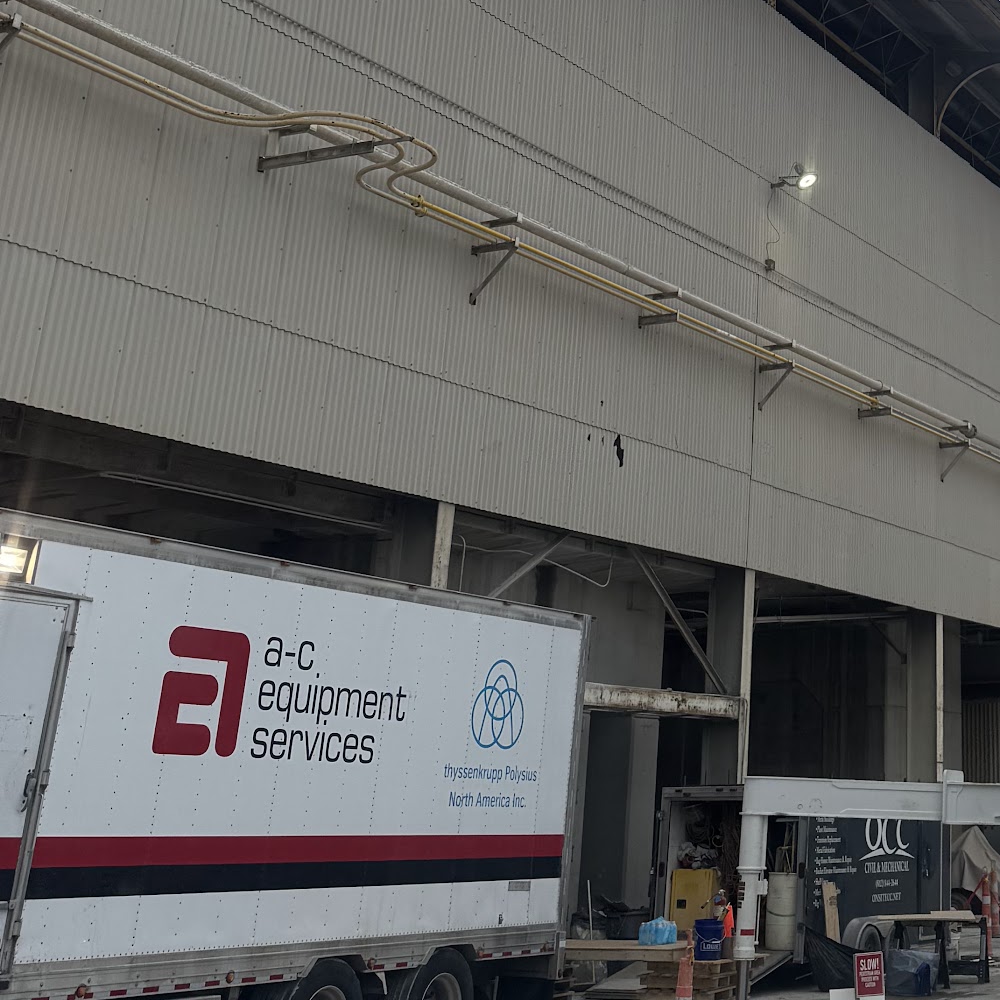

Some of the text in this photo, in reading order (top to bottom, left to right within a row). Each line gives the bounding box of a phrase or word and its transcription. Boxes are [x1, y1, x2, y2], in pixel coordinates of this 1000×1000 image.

[264, 636, 315, 671] a-c
[257, 672, 407, 725] equipment
[250, 719, 376, 764] services
[443, 763, 538, 784] thyssenkrupp Polysius
[448, 791, 527, 808] North America Inc.
[864, 862, 877, 874] CIVIL
[881, 860, 910, 873] MECHANICAL
[860, 957, 880, 971] SLOW!
